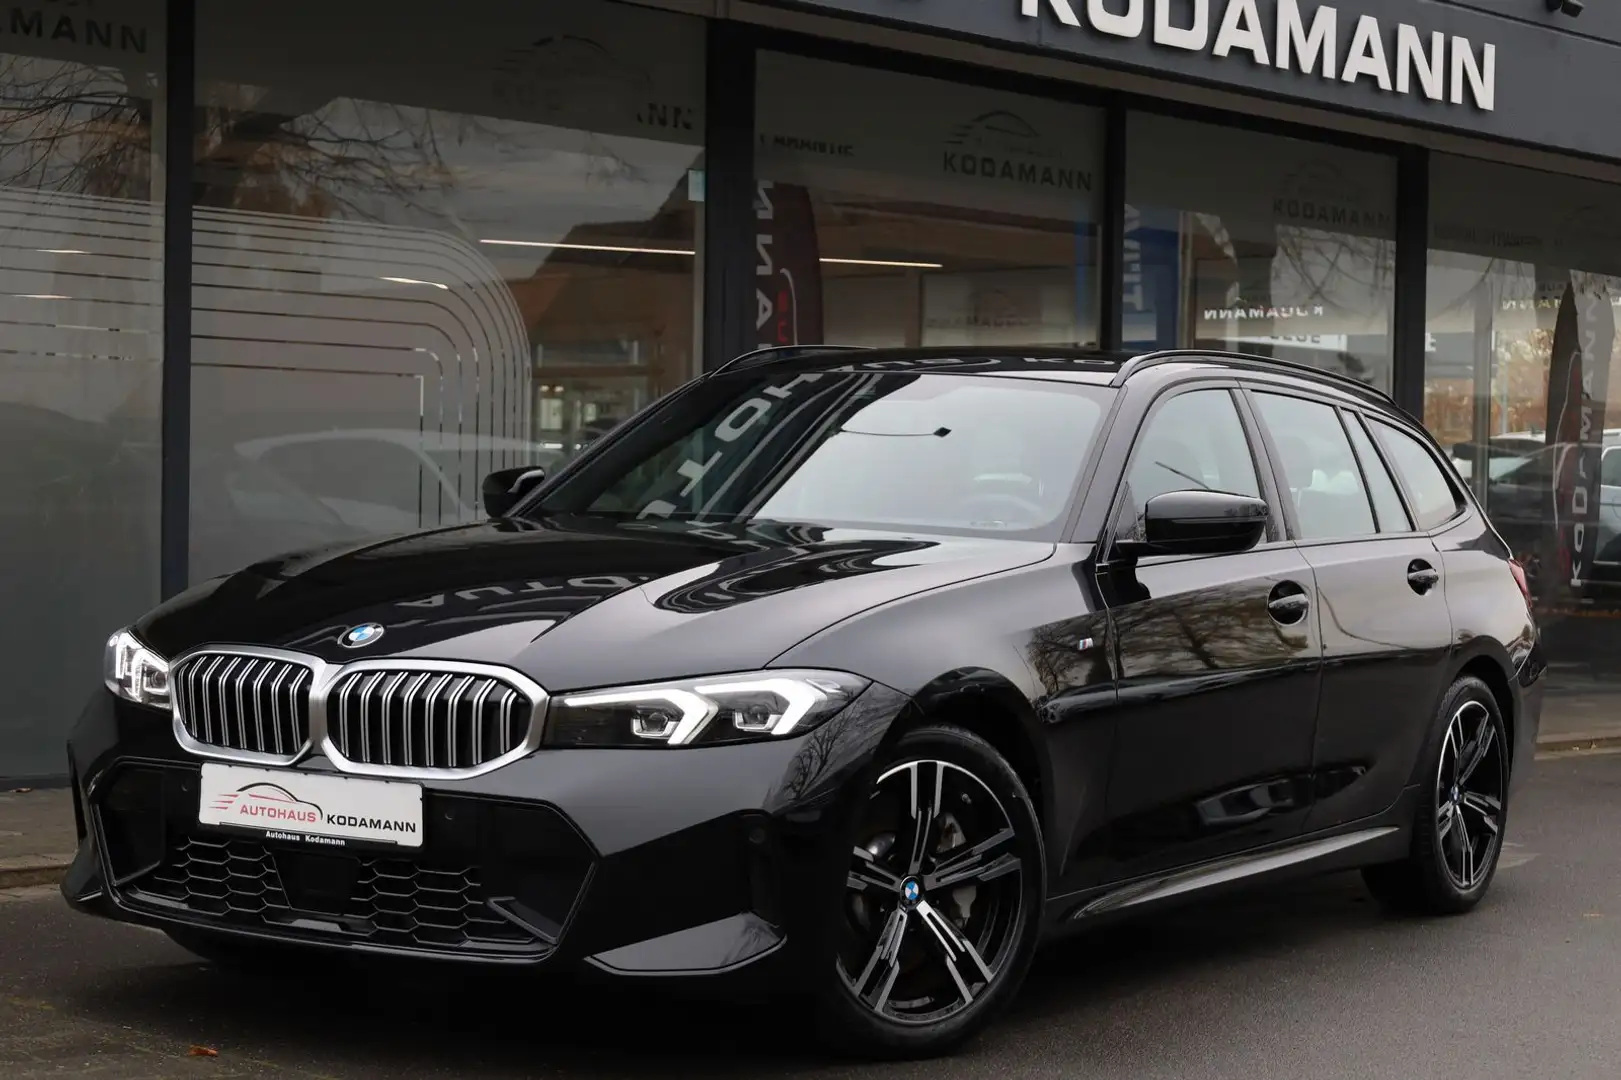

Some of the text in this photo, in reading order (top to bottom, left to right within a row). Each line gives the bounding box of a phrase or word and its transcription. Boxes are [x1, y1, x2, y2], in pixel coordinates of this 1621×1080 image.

[0, 7, 146, 54] MANN
[1022, 0, 1496, 112] DAMANN
[943, 150, 1093, 191] KODAMANN
[240, 804, 416, 833] AUTOHAUS KODAMANN
[265, 831, 346, 847] Autohaus Kodamann
